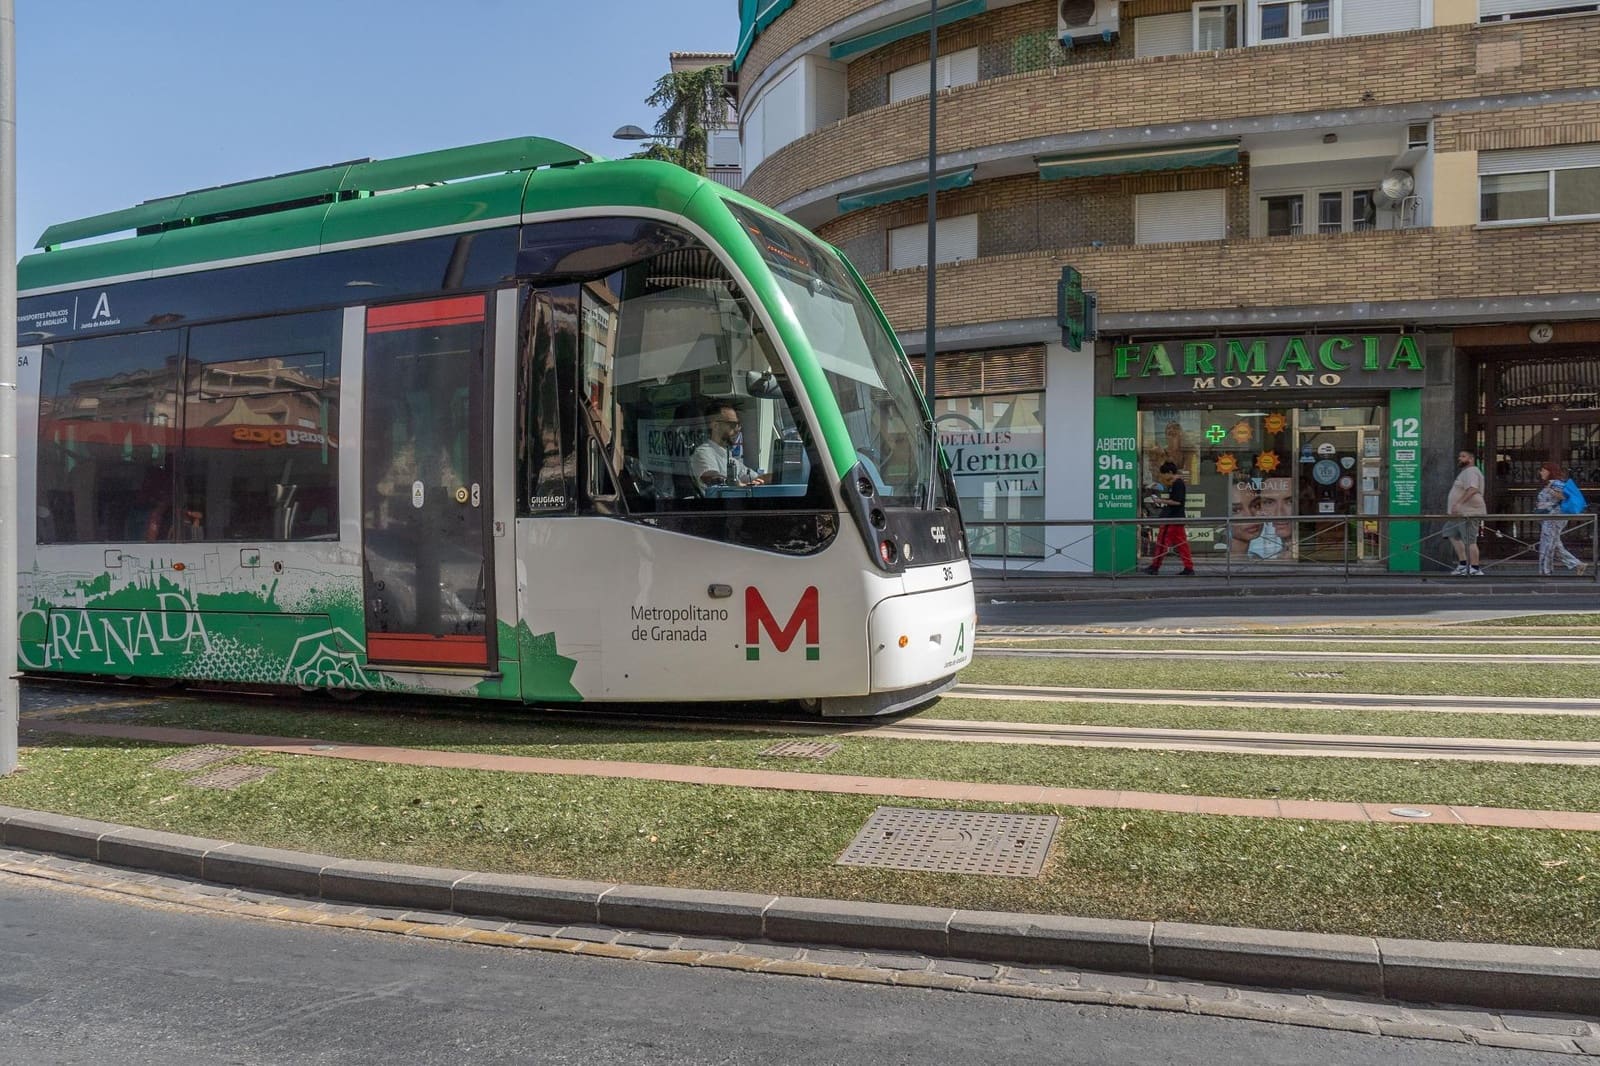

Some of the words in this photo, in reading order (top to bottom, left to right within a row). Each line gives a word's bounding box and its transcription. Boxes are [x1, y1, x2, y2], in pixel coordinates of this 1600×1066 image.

[1113, 336, 1425, 379] FARMACIA
[1191, 373, 1342, 391] MOYANO
[1392, 417, 1419, 438] 12
[941, 431, 1012, 447] DETALLES
[1096, 437, 1136, 451] ABIERTO
[948, 446, 1038, 472] Merino
[1098, 454, 1124, 470] 9h
[1125, 461, 1133, 470] a
[1098, 474, 1133, 490] 21h
[531, 496, 565, 504] GIUGIARO
[1099, 493, 1109, 501] De
[1111, 493, 1133, 501] Lunes
[1105, 501, 1133, 509] Viernes
[630, 604, 729, 623] Metropolitano
[18, 592, 213, 668] GRANADA
[631, 626, 647, 641] de
[651, 626, 707, 642] Granada
